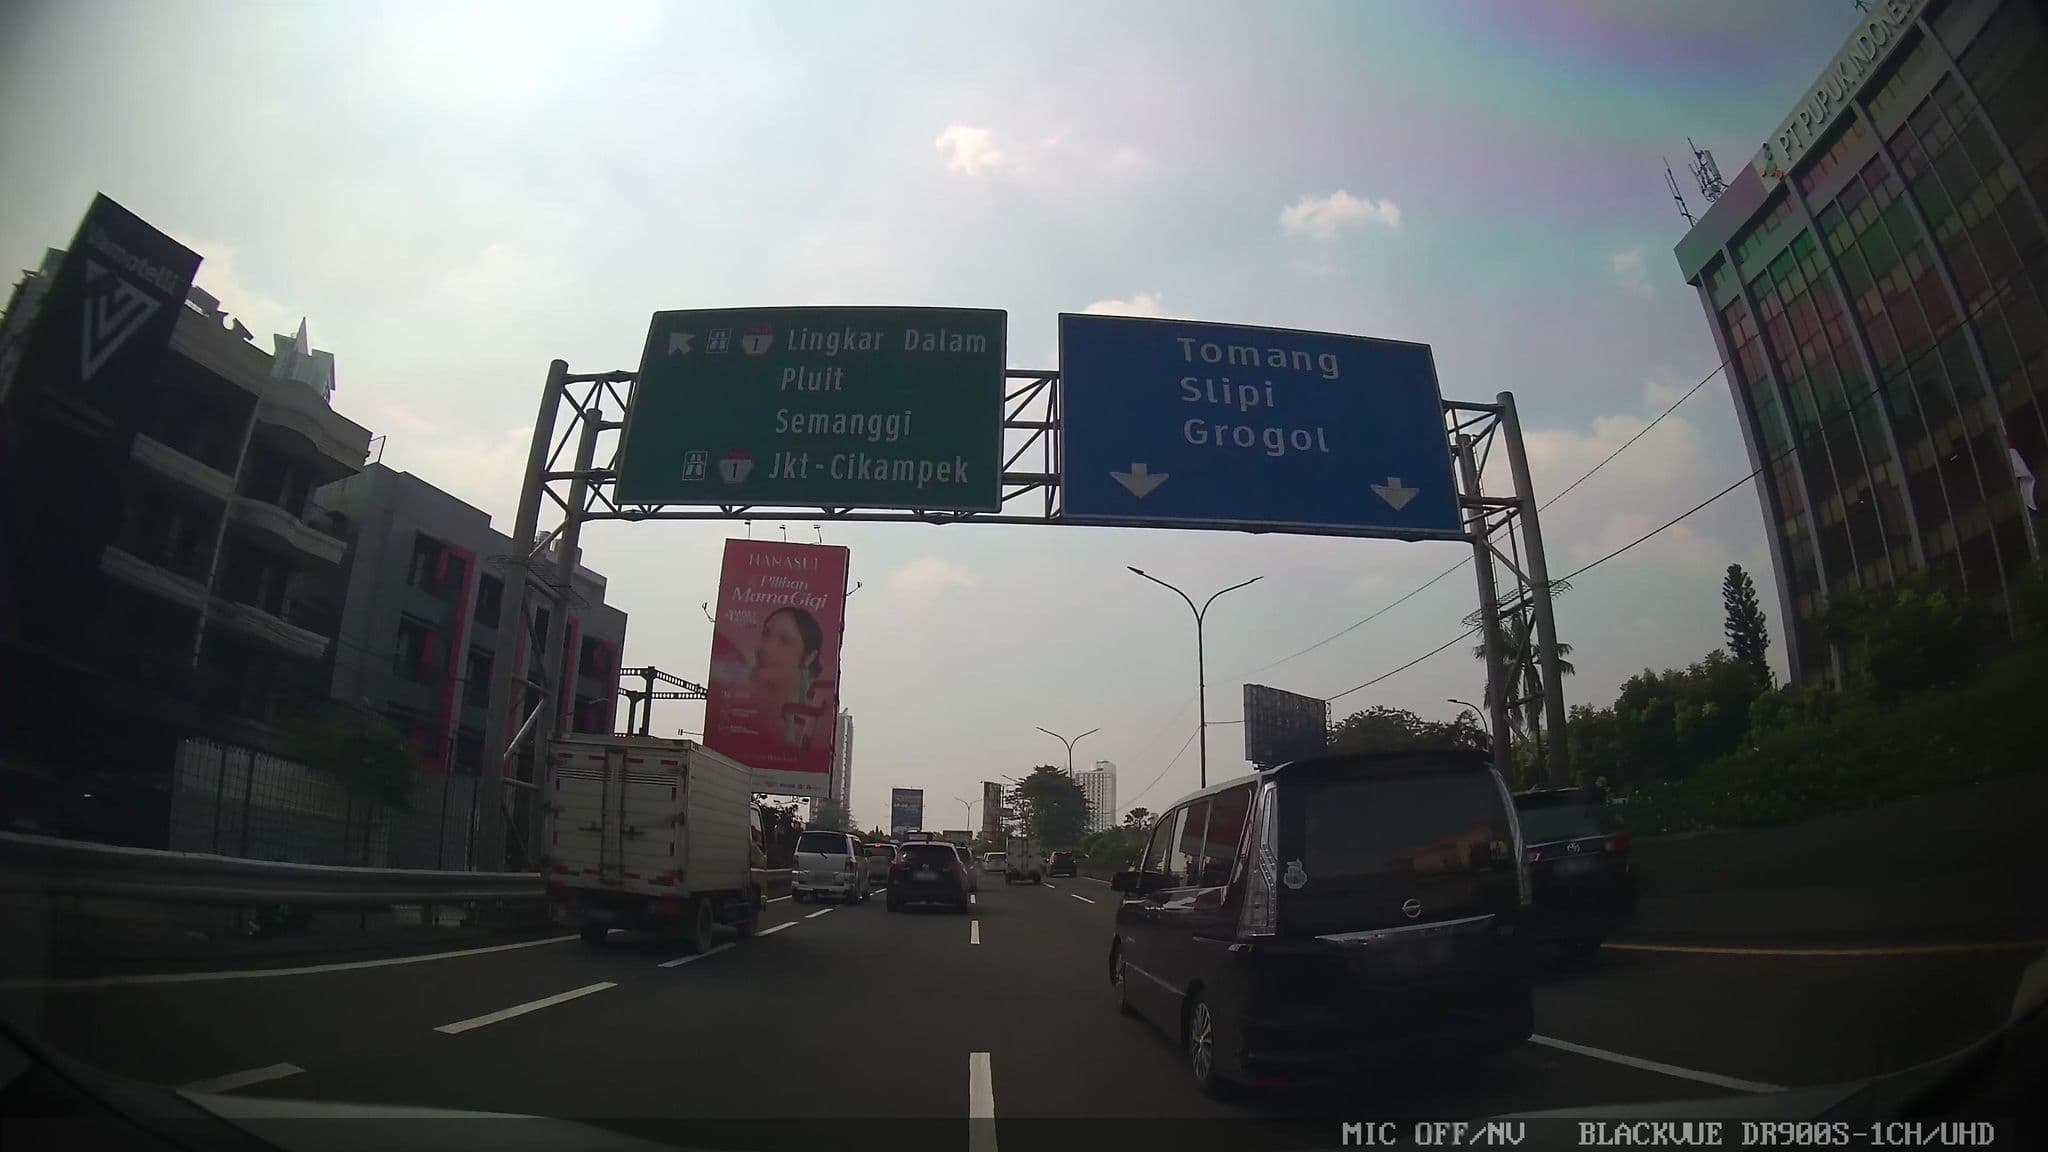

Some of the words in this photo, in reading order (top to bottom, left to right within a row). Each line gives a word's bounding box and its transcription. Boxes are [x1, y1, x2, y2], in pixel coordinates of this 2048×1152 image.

[1778, 122, 1803, 160] PT
[1800, 61, 1856, 137] PUPUK
[787, 327, 883, 359] Lingkar
[905, 328, 986, 353] Dalam
[1177, 337, 1340, 380] Tomang
[781, 366, 844, 392] Pluit
[1180, 375, 1274, 411] Slipi
[775, 408, 912, 442] Semanggi
[1183, 418, 1330, 457] Grogol
[768, 451, 969, 488] Jkt-Cikampek
